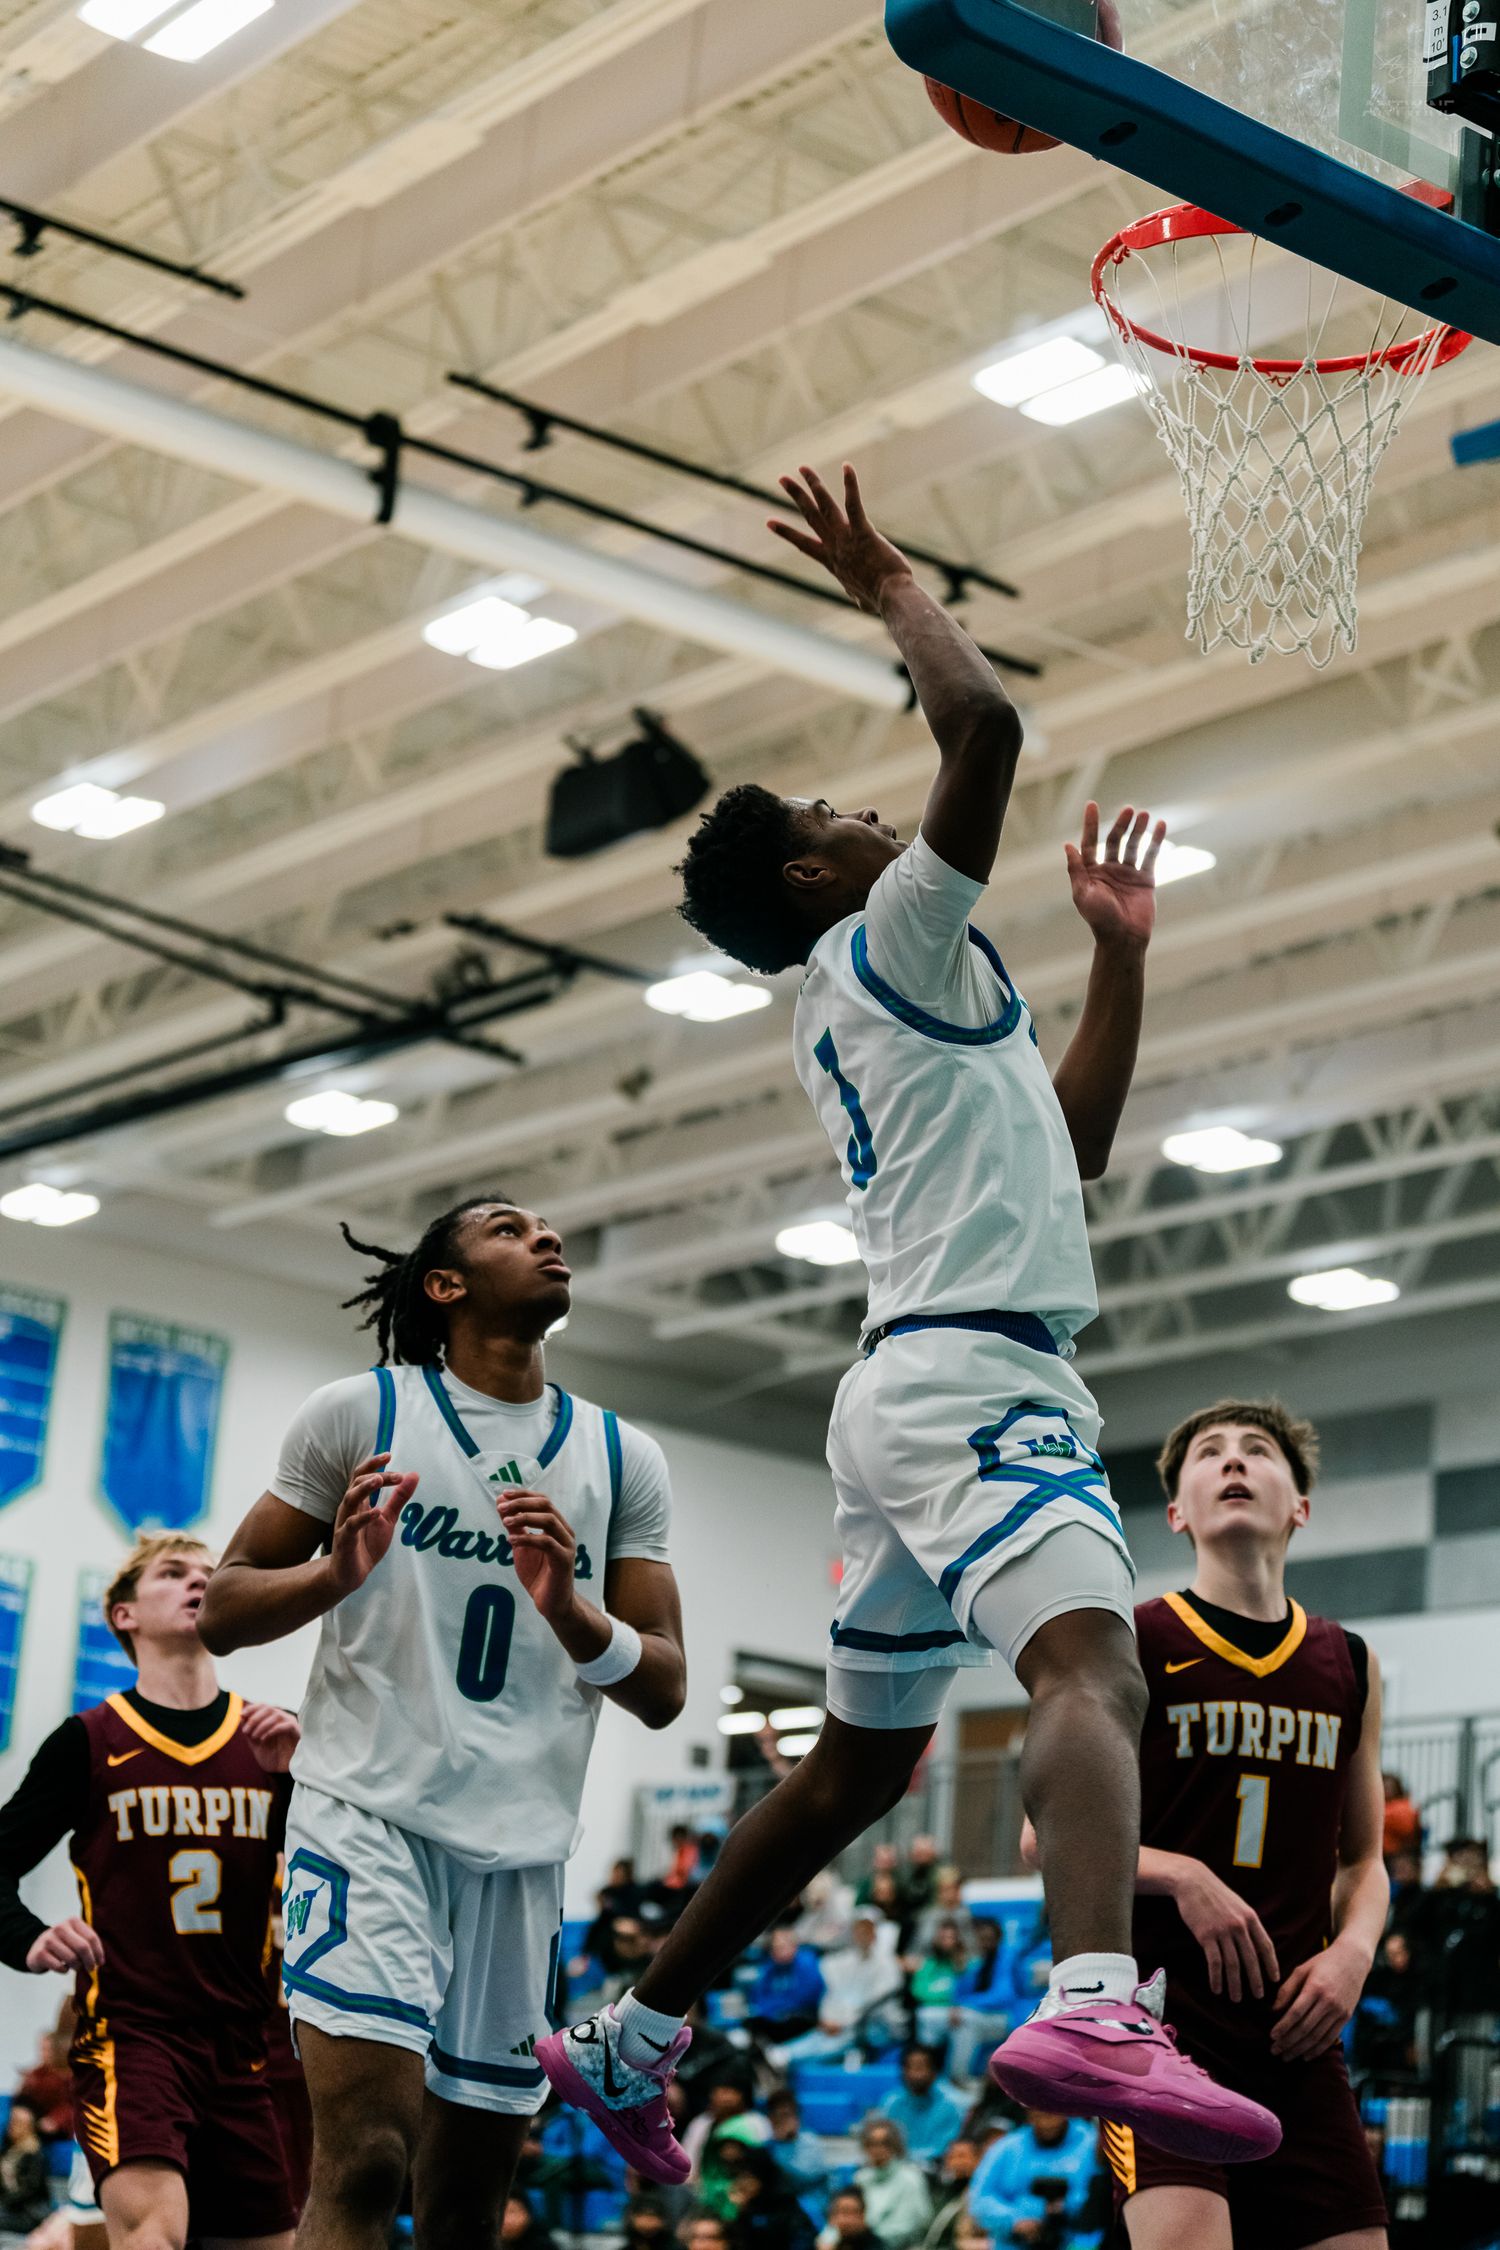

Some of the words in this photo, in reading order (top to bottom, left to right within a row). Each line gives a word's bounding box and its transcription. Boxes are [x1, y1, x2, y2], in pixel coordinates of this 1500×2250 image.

[1432, 6, 1447, 21] 3.1
[1433, 26, 1444, 37] m
[401, 1502, 593, 1580] Warrs
[456, 1584, 515, 1702] 0
[1166, 1701, 1341, 1770] TURPIN
[107, 1786, 273, 1842] TURPIN
[1232, 1773, 1270, 1868] 1
[168, 1849, 222, 1935] 2
